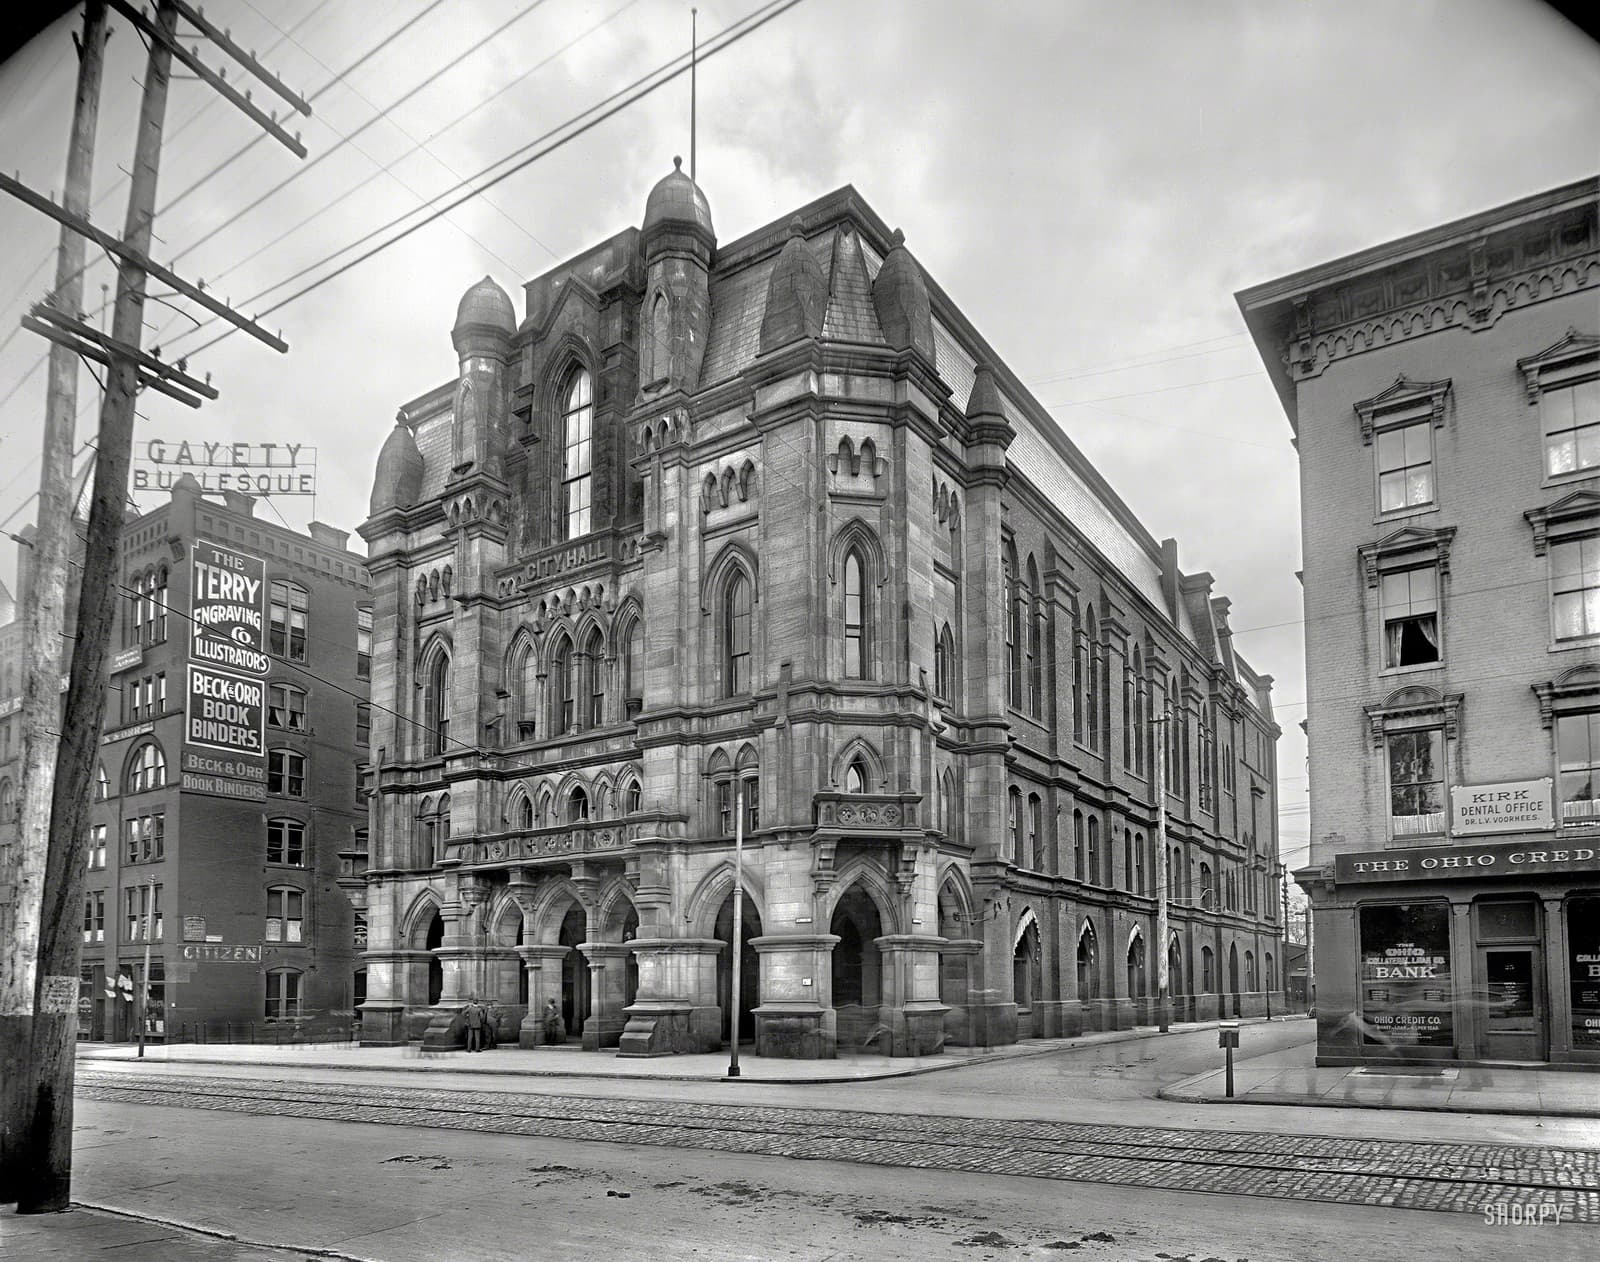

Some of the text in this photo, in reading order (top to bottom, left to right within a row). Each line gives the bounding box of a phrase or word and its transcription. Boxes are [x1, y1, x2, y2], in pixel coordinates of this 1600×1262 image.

[148, 439, 302, 468] GAYETY
[134, 470, 312, 494] BULESQUE
[212, 550, 245, 571] THE
[525, 540, 606, 581] CITY HALL
[195, 561, 261, 604] TERRY
[193, 605, 261, 637] ENGRAVING
[195, 637, 267, 671] ILLUSTRATORS
[193, 671, 230, 701] BECK
[234, 681, 260, 707] ORR
[203, 698, 249, 726] BOOK
[192, 718, 260, 749] BINDERS.
[225, 762, 235, 775] &
[1472, 790, 1529, 803] KIRK
[1461, 801, 1543, 817] DENTAL OFFICE
[1465, 818, 1477, 826] DR.
[1353, 849, 1600, 873] THE OHIO CRED
[184, 946, 257, 959] CITIZEN
[1385, 948, 1425, 957] OHIO
[1375, 966, 1437, 978] BANK
[1374, 1016, 1394, 1025] OHIO
[1395, 1016, 1426, 1025] CREDIT
